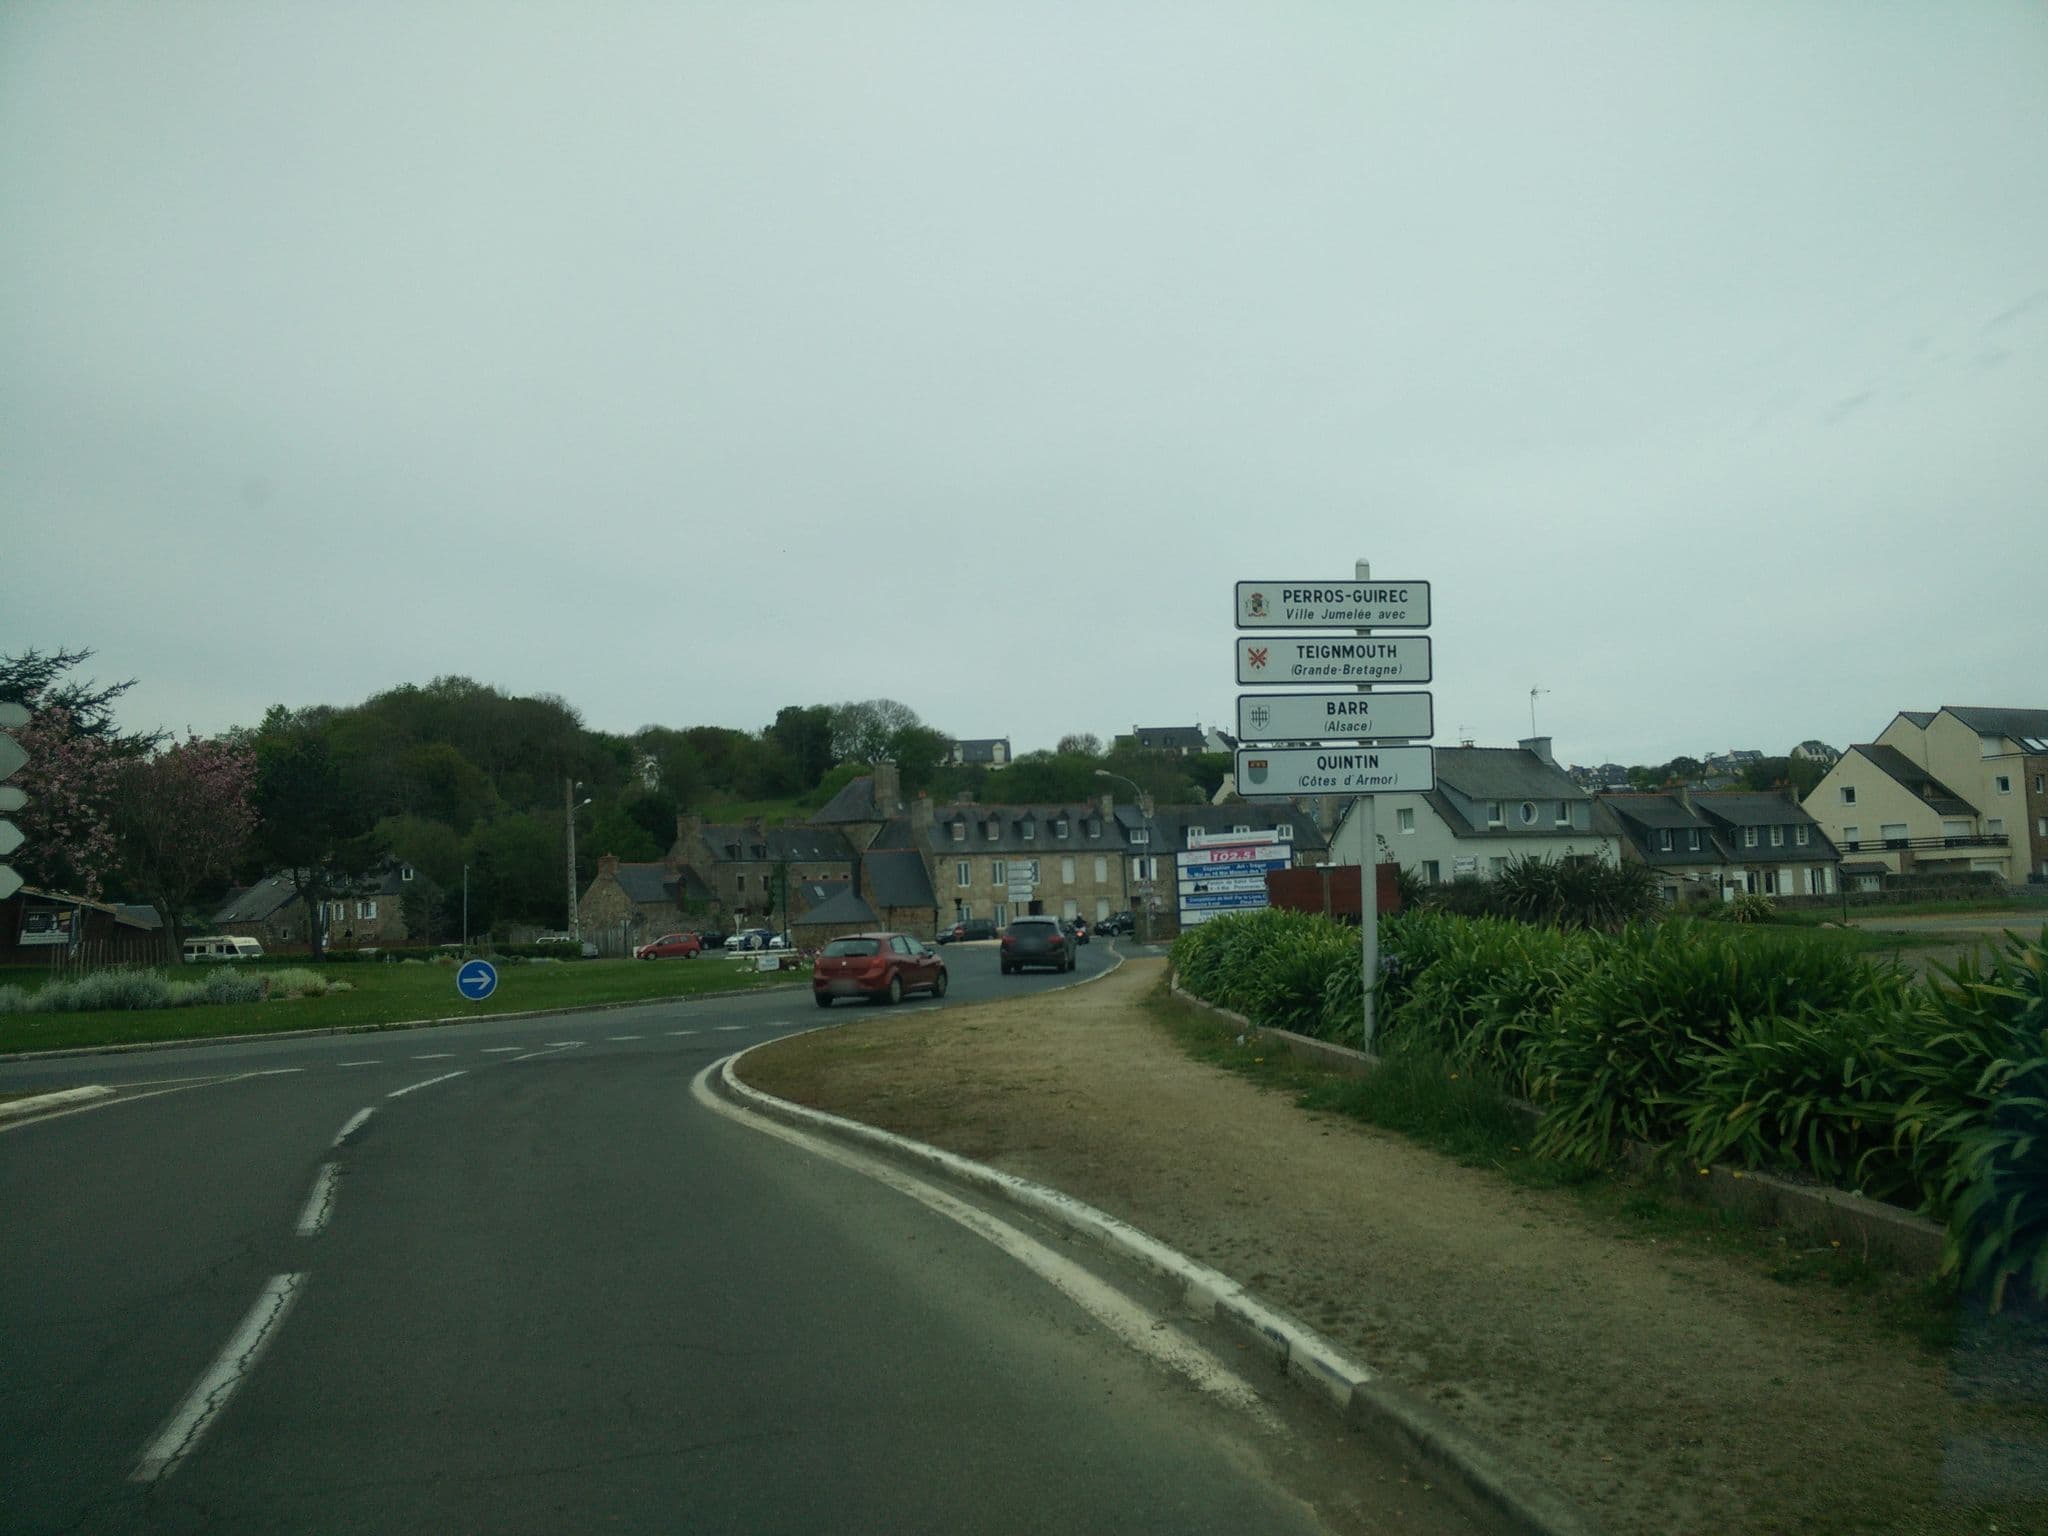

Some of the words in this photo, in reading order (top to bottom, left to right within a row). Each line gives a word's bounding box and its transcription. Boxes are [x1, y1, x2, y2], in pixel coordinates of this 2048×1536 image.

[1283, 589, 1408, 604] PERROS-GUIREC
[1286, 609, 1314, 619] Ville
[1321, 608, 1372, 619] Jumelée
[1378, 611, 1406, 619] avec
[1297, 645, 1397, 658] TEIGNMOUTH
[1291, 664, 1402, 678] (Grande-Bretagne)
[1327, 702, 1368, 715] BARR
[1324, 720, 1372, 732] (Alsace)
[1317, 755, 1378, 769] QUINTIN
[1298, 776, 1337, 787] (Côtes
